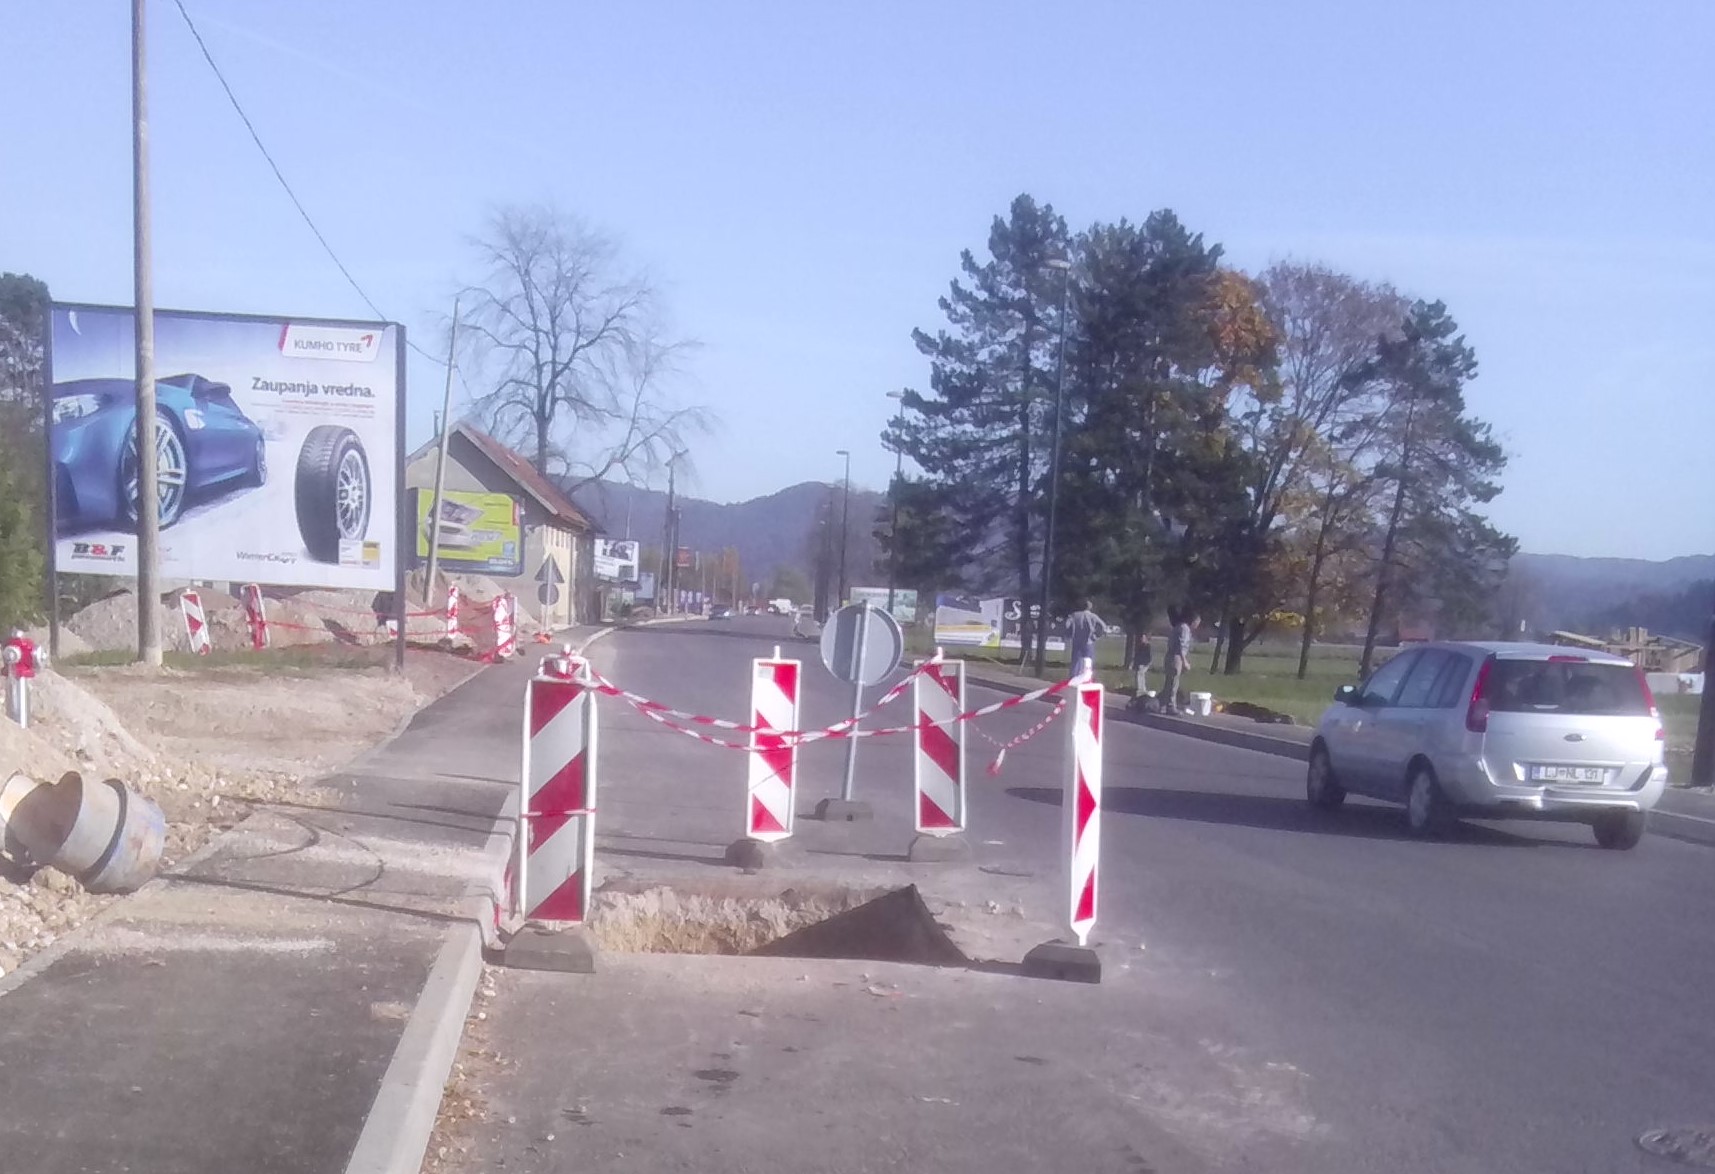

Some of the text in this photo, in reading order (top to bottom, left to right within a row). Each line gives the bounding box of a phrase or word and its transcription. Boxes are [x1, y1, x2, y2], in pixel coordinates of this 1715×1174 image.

[294, 339, 362, 353] KUMHO TYRE
[252, 377, 376, 398] Zaupanja vredna.
